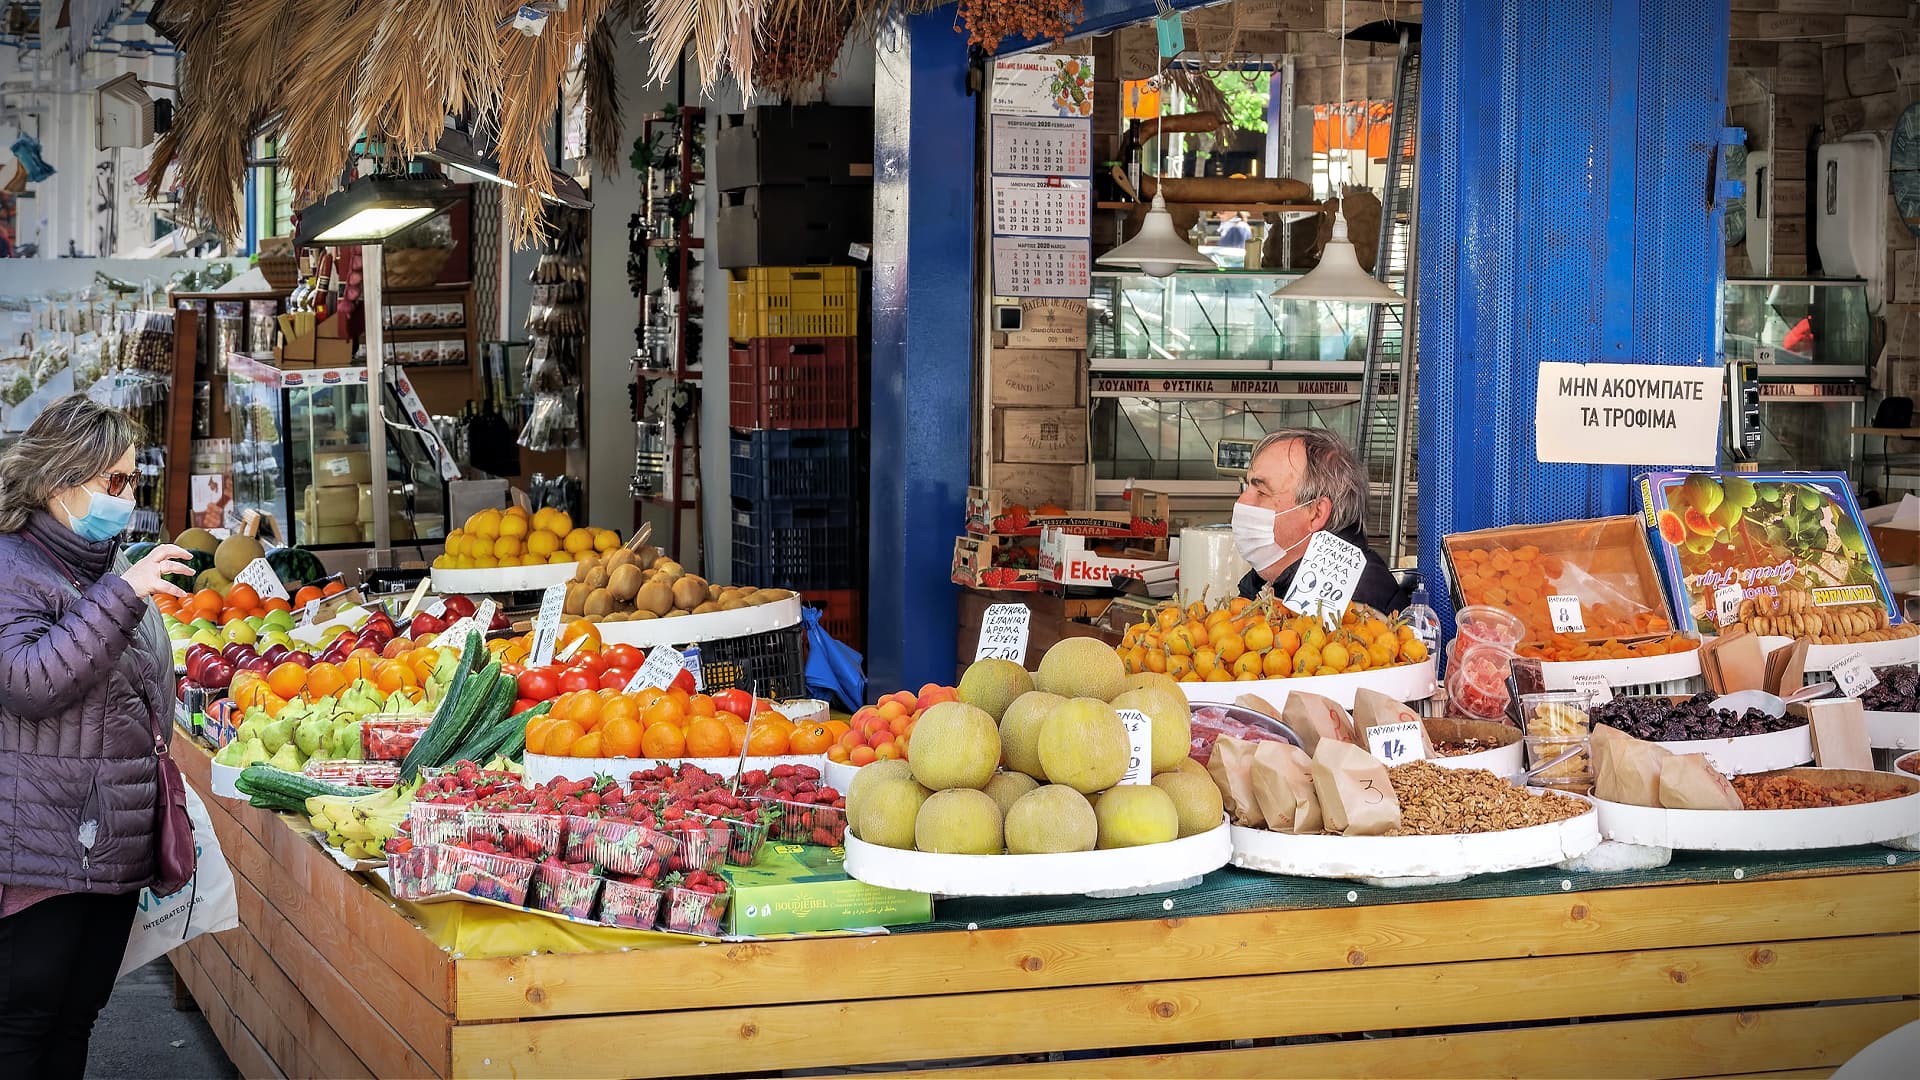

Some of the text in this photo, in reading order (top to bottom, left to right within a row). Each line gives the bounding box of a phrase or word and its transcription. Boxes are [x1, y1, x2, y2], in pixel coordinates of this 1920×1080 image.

[1098, 380, 1150, 392] ΧΟΥΑΝΙΤΑ
[1162, 380, 1214, 392] ΦΥΣΤΙΚΙΑ
[1231, 380, 1280, 393] ΜΠΡΑΖΙΛ
[1559, 377, 1598, 397] ΜΗΝ
[1601, 378, 1704, 401] ΑΚΟΥΜΠΑΤΕ
[1758, 384, 1796, 396] ΥΣΤΙΚΙΑ
[1581, 407, 1677, 429] ΤΑ ΤΡΟΦΙΜΑ
[1560, 607, 1570, 623] 8
[1382, 739, 1407, 760] 14
[1359, 779, 1384, 804] 3
[142, 905, 186, 931] INTEGRATED
